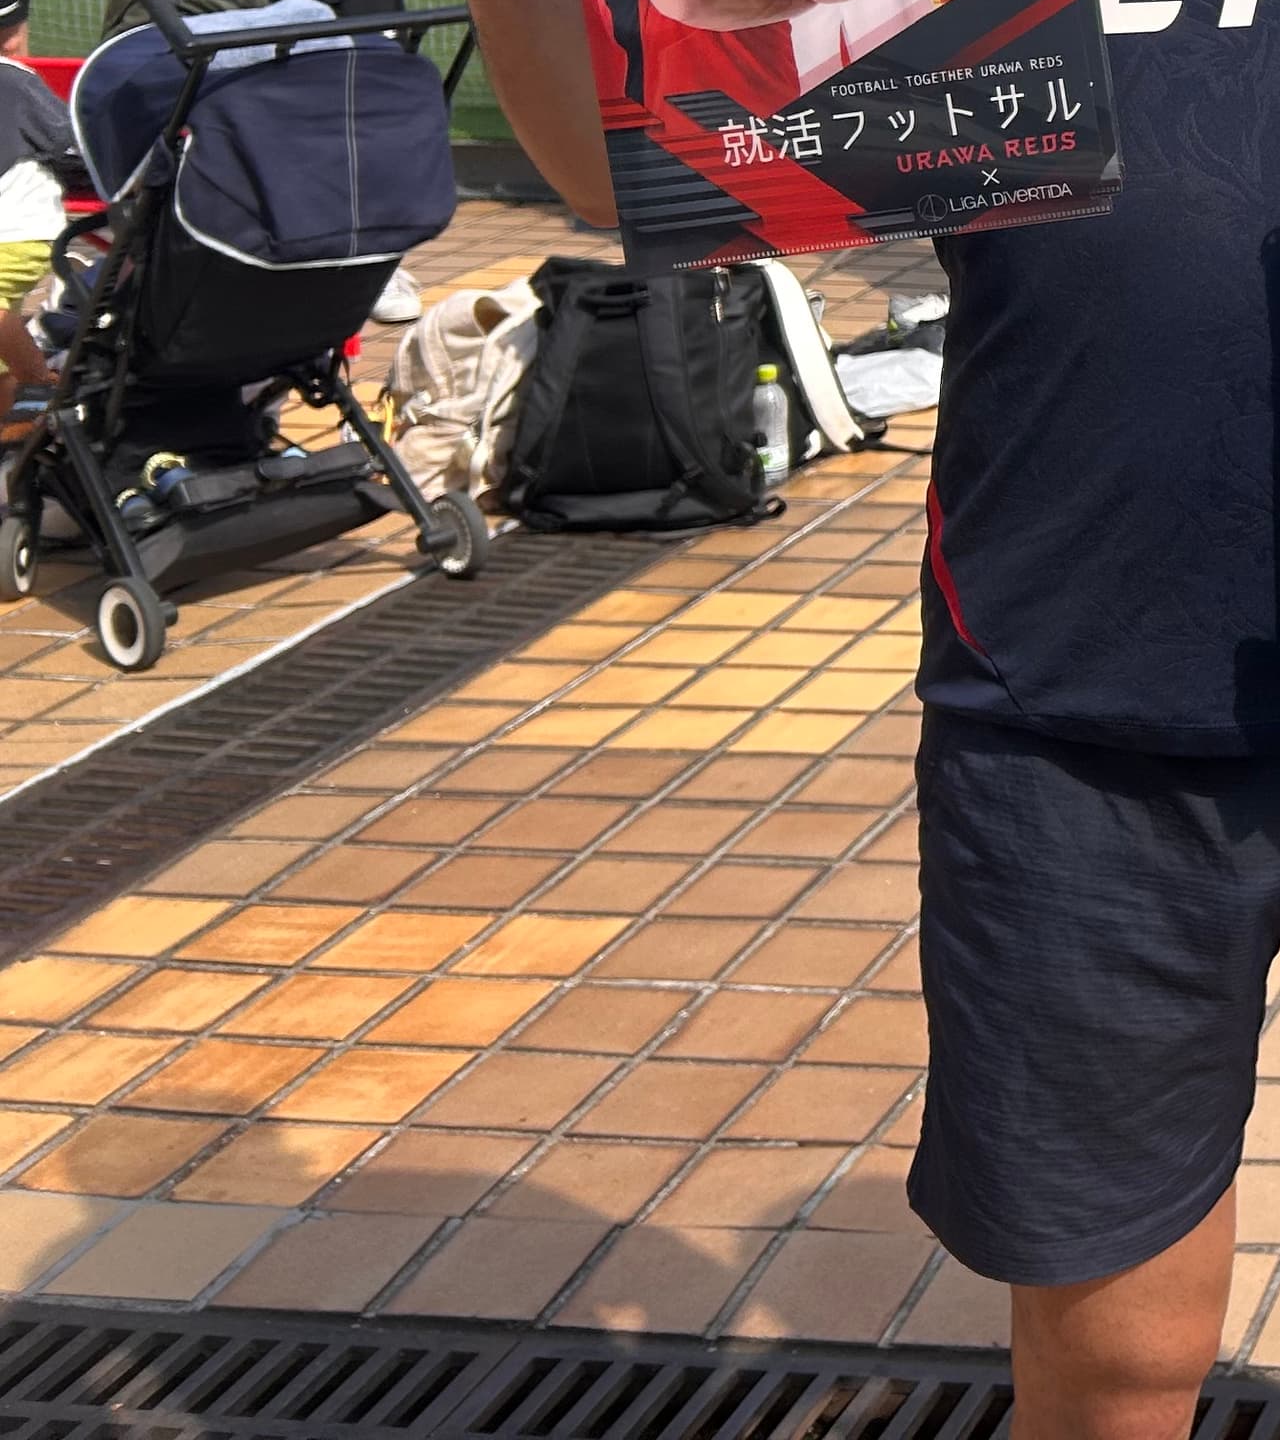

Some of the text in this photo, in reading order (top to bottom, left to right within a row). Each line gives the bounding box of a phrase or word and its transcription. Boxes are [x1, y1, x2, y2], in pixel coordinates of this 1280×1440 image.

[831, 55, 1064, 97] FOOTBALL TOGETHER URAWA REDS
[718, 78, 1082, 167] 就活フットサル
[897, 130, 1077, 173] URAWA REDS
